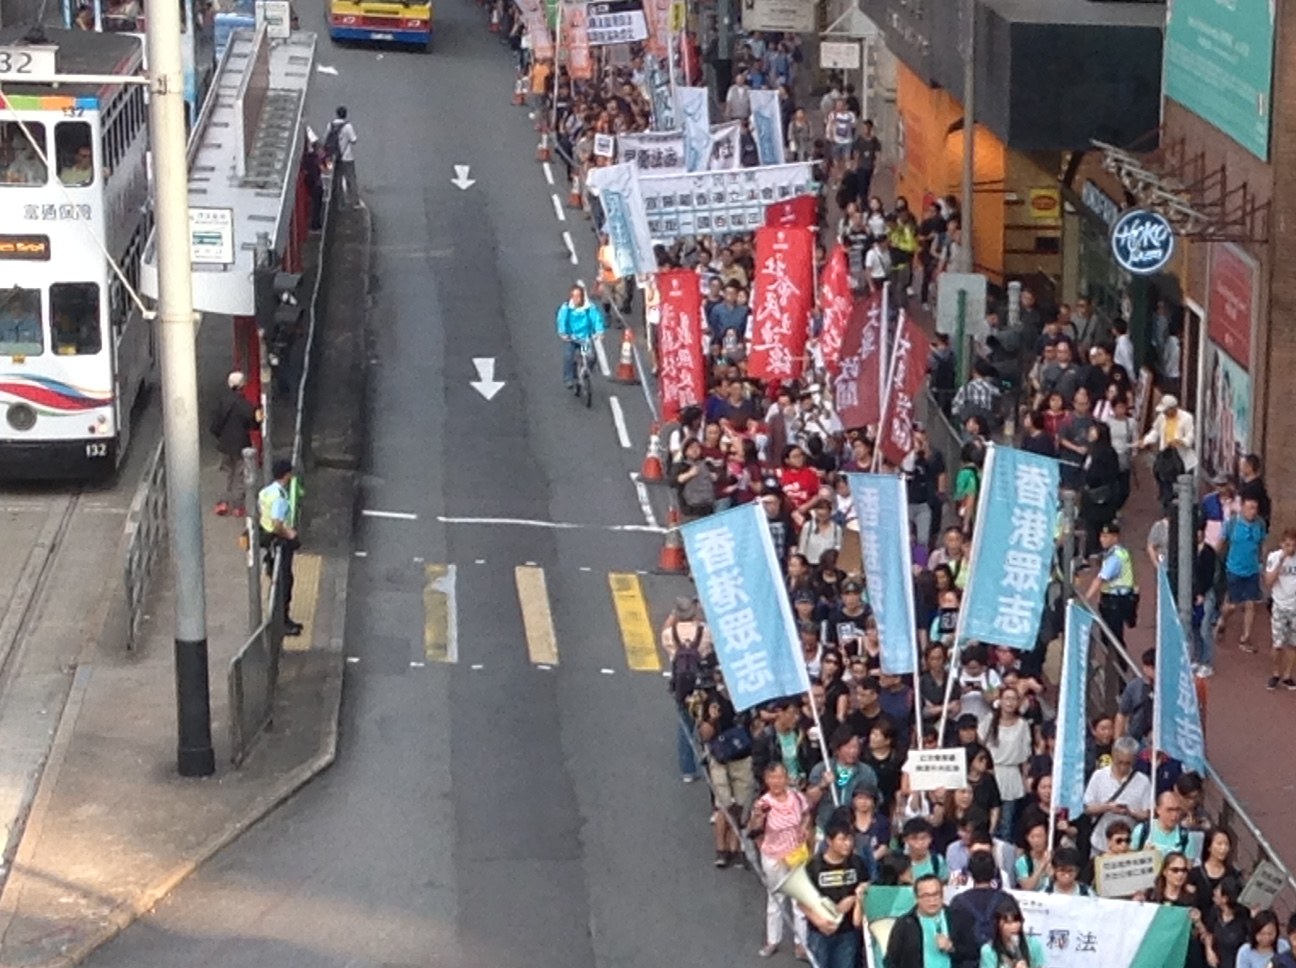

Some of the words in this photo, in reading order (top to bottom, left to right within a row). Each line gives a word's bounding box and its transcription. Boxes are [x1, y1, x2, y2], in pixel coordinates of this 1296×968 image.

[85, 443, 107, 457] 132
[994, 464, 1051, 636] 香港眾志
